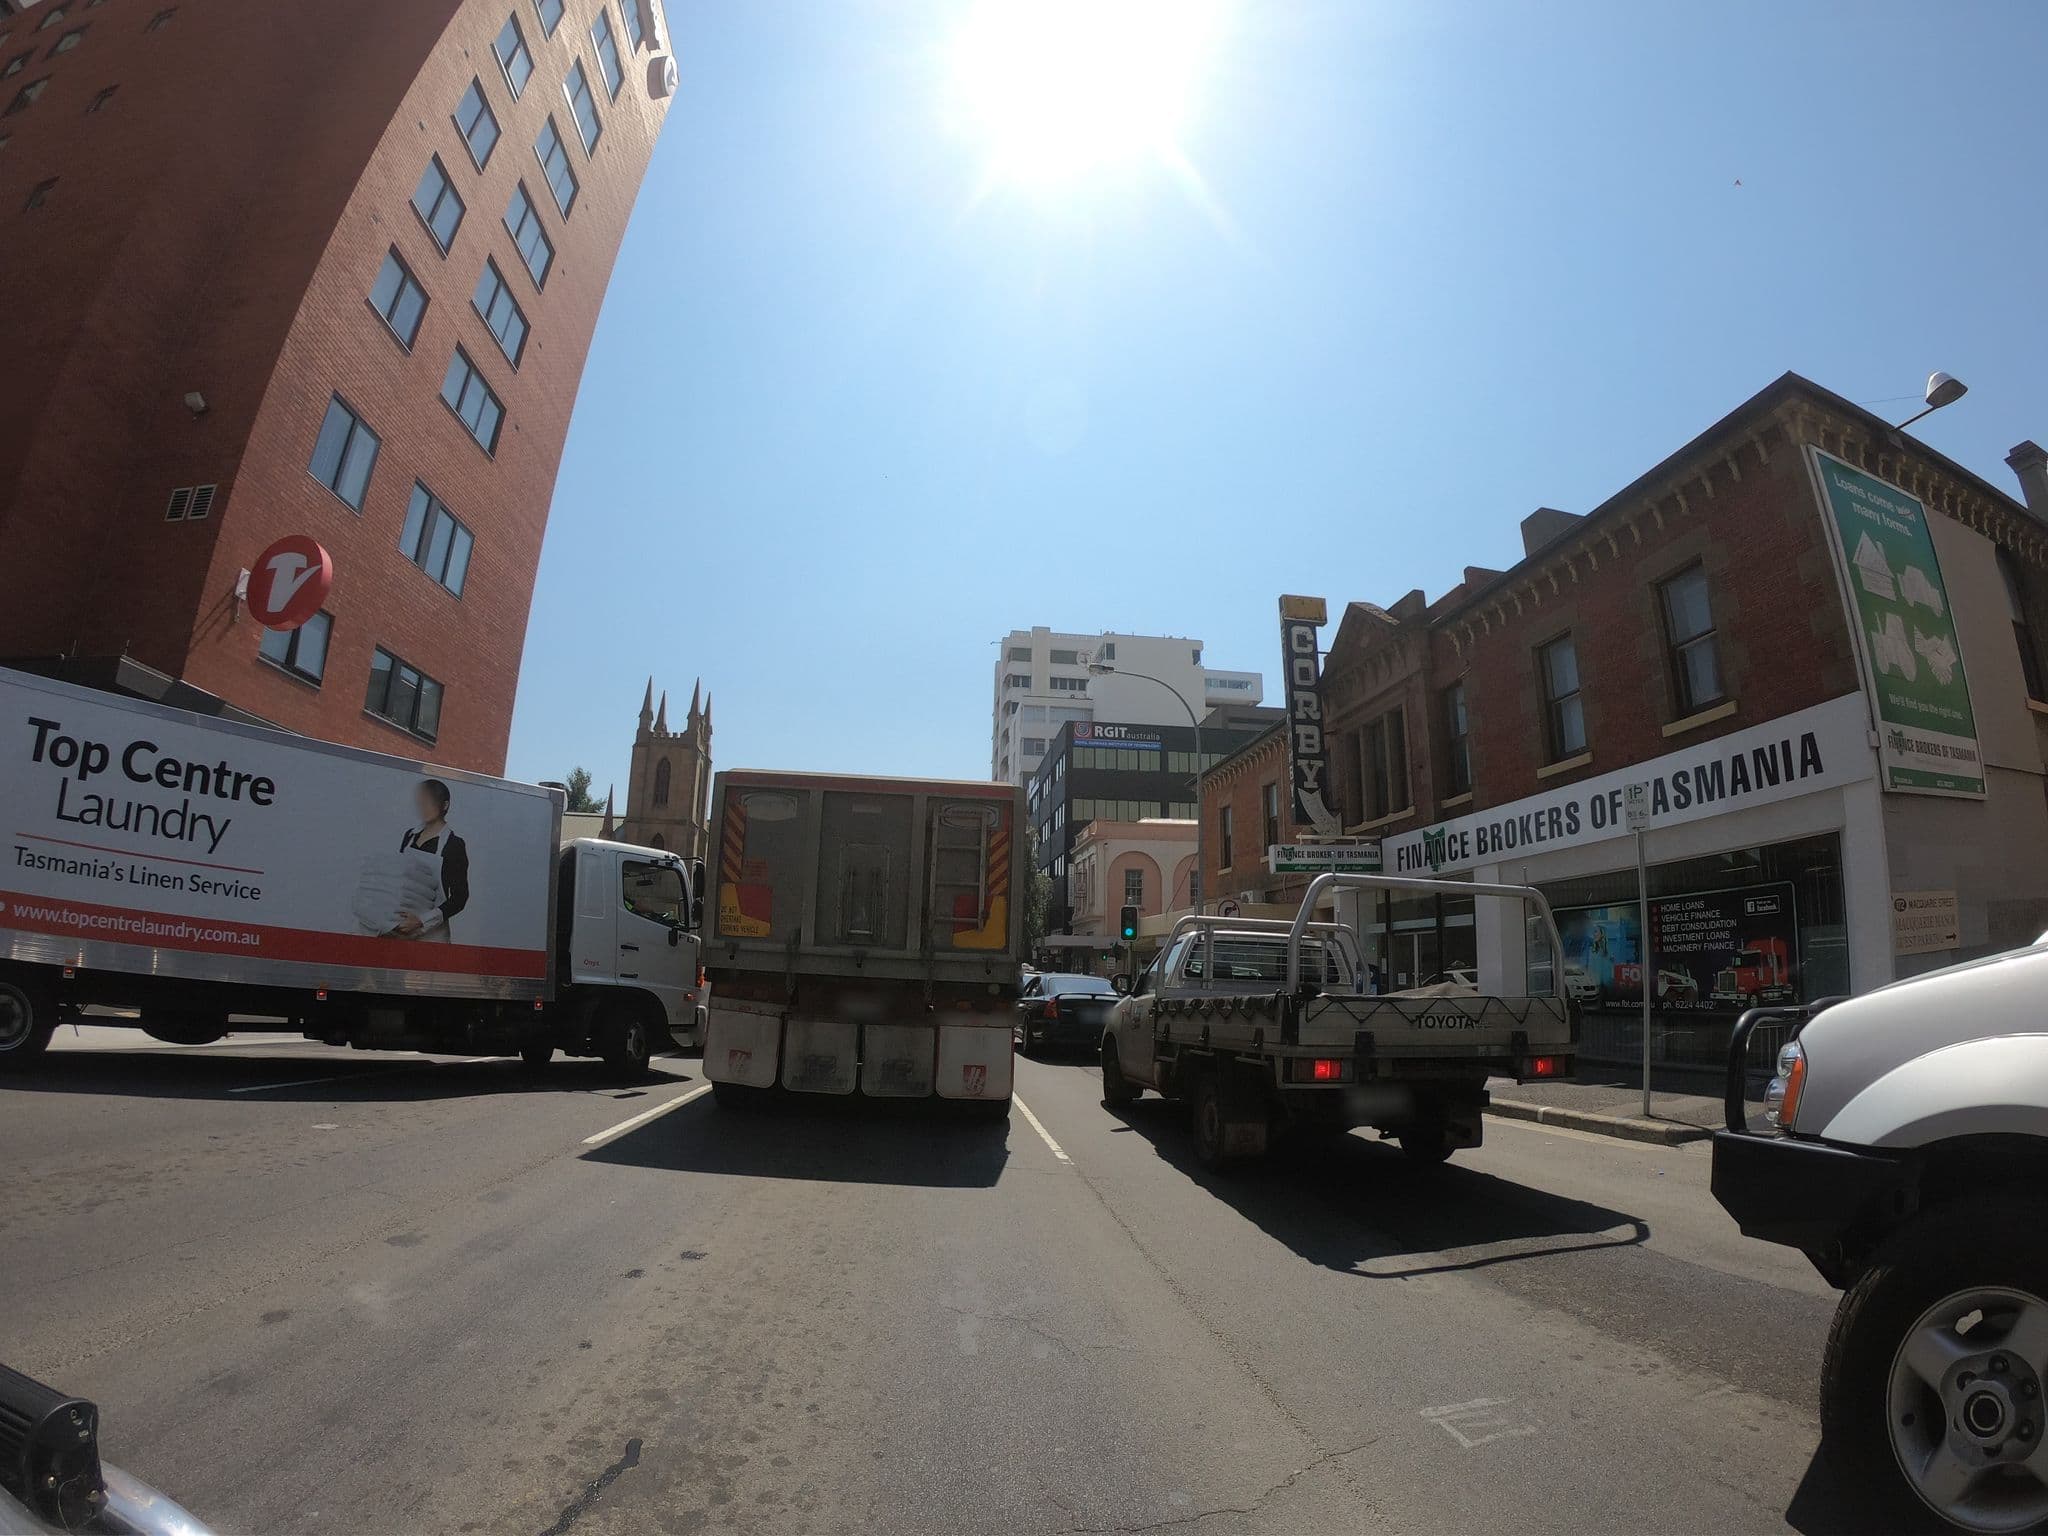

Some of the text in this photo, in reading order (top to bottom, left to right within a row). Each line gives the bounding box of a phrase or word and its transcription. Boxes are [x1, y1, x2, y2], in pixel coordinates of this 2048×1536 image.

[1833, 473, 1866, 498] Loans
[1867, 491, 1895, 512] come
[1852, 502, 1881, 525] many
[1291, 625, 1325, 789] CORBY
[1094, 726, 1128, 738] RGIT
[1888, 735, 1915, 752] FINANCE
[1915, 740, 1941, 757] BROKERS
[1941, 744, 1949, 758] OF
[28, 716, 275, 806] Top Centre
[1397, 732, 1823, 872] FINANCE BROKERS OF ASMANIA
[56, 777, 231, 854] Laundry
[1277, 850, 1379, 859] FINANCE BROKER OF TASMANIA
[14, 846, 261, 900] Tasmania's Linen Service
[1660, 901, 1705, 912] HOME LOANS
[1661, 910, 1721, 922] VEHICLE FINANCE
[13, 903, 261, 946] www.topcentrelaundry.com.au
[1662, 919, 1737, 933] DEBT CONSOLIDATION
[1662, 930, 1730, 943] INVESTMENT LOANS
[1662, 941, 1736, 952] MACHINERY FINANCE
[1416, 1015, 1474, 1029] TOYOTA
